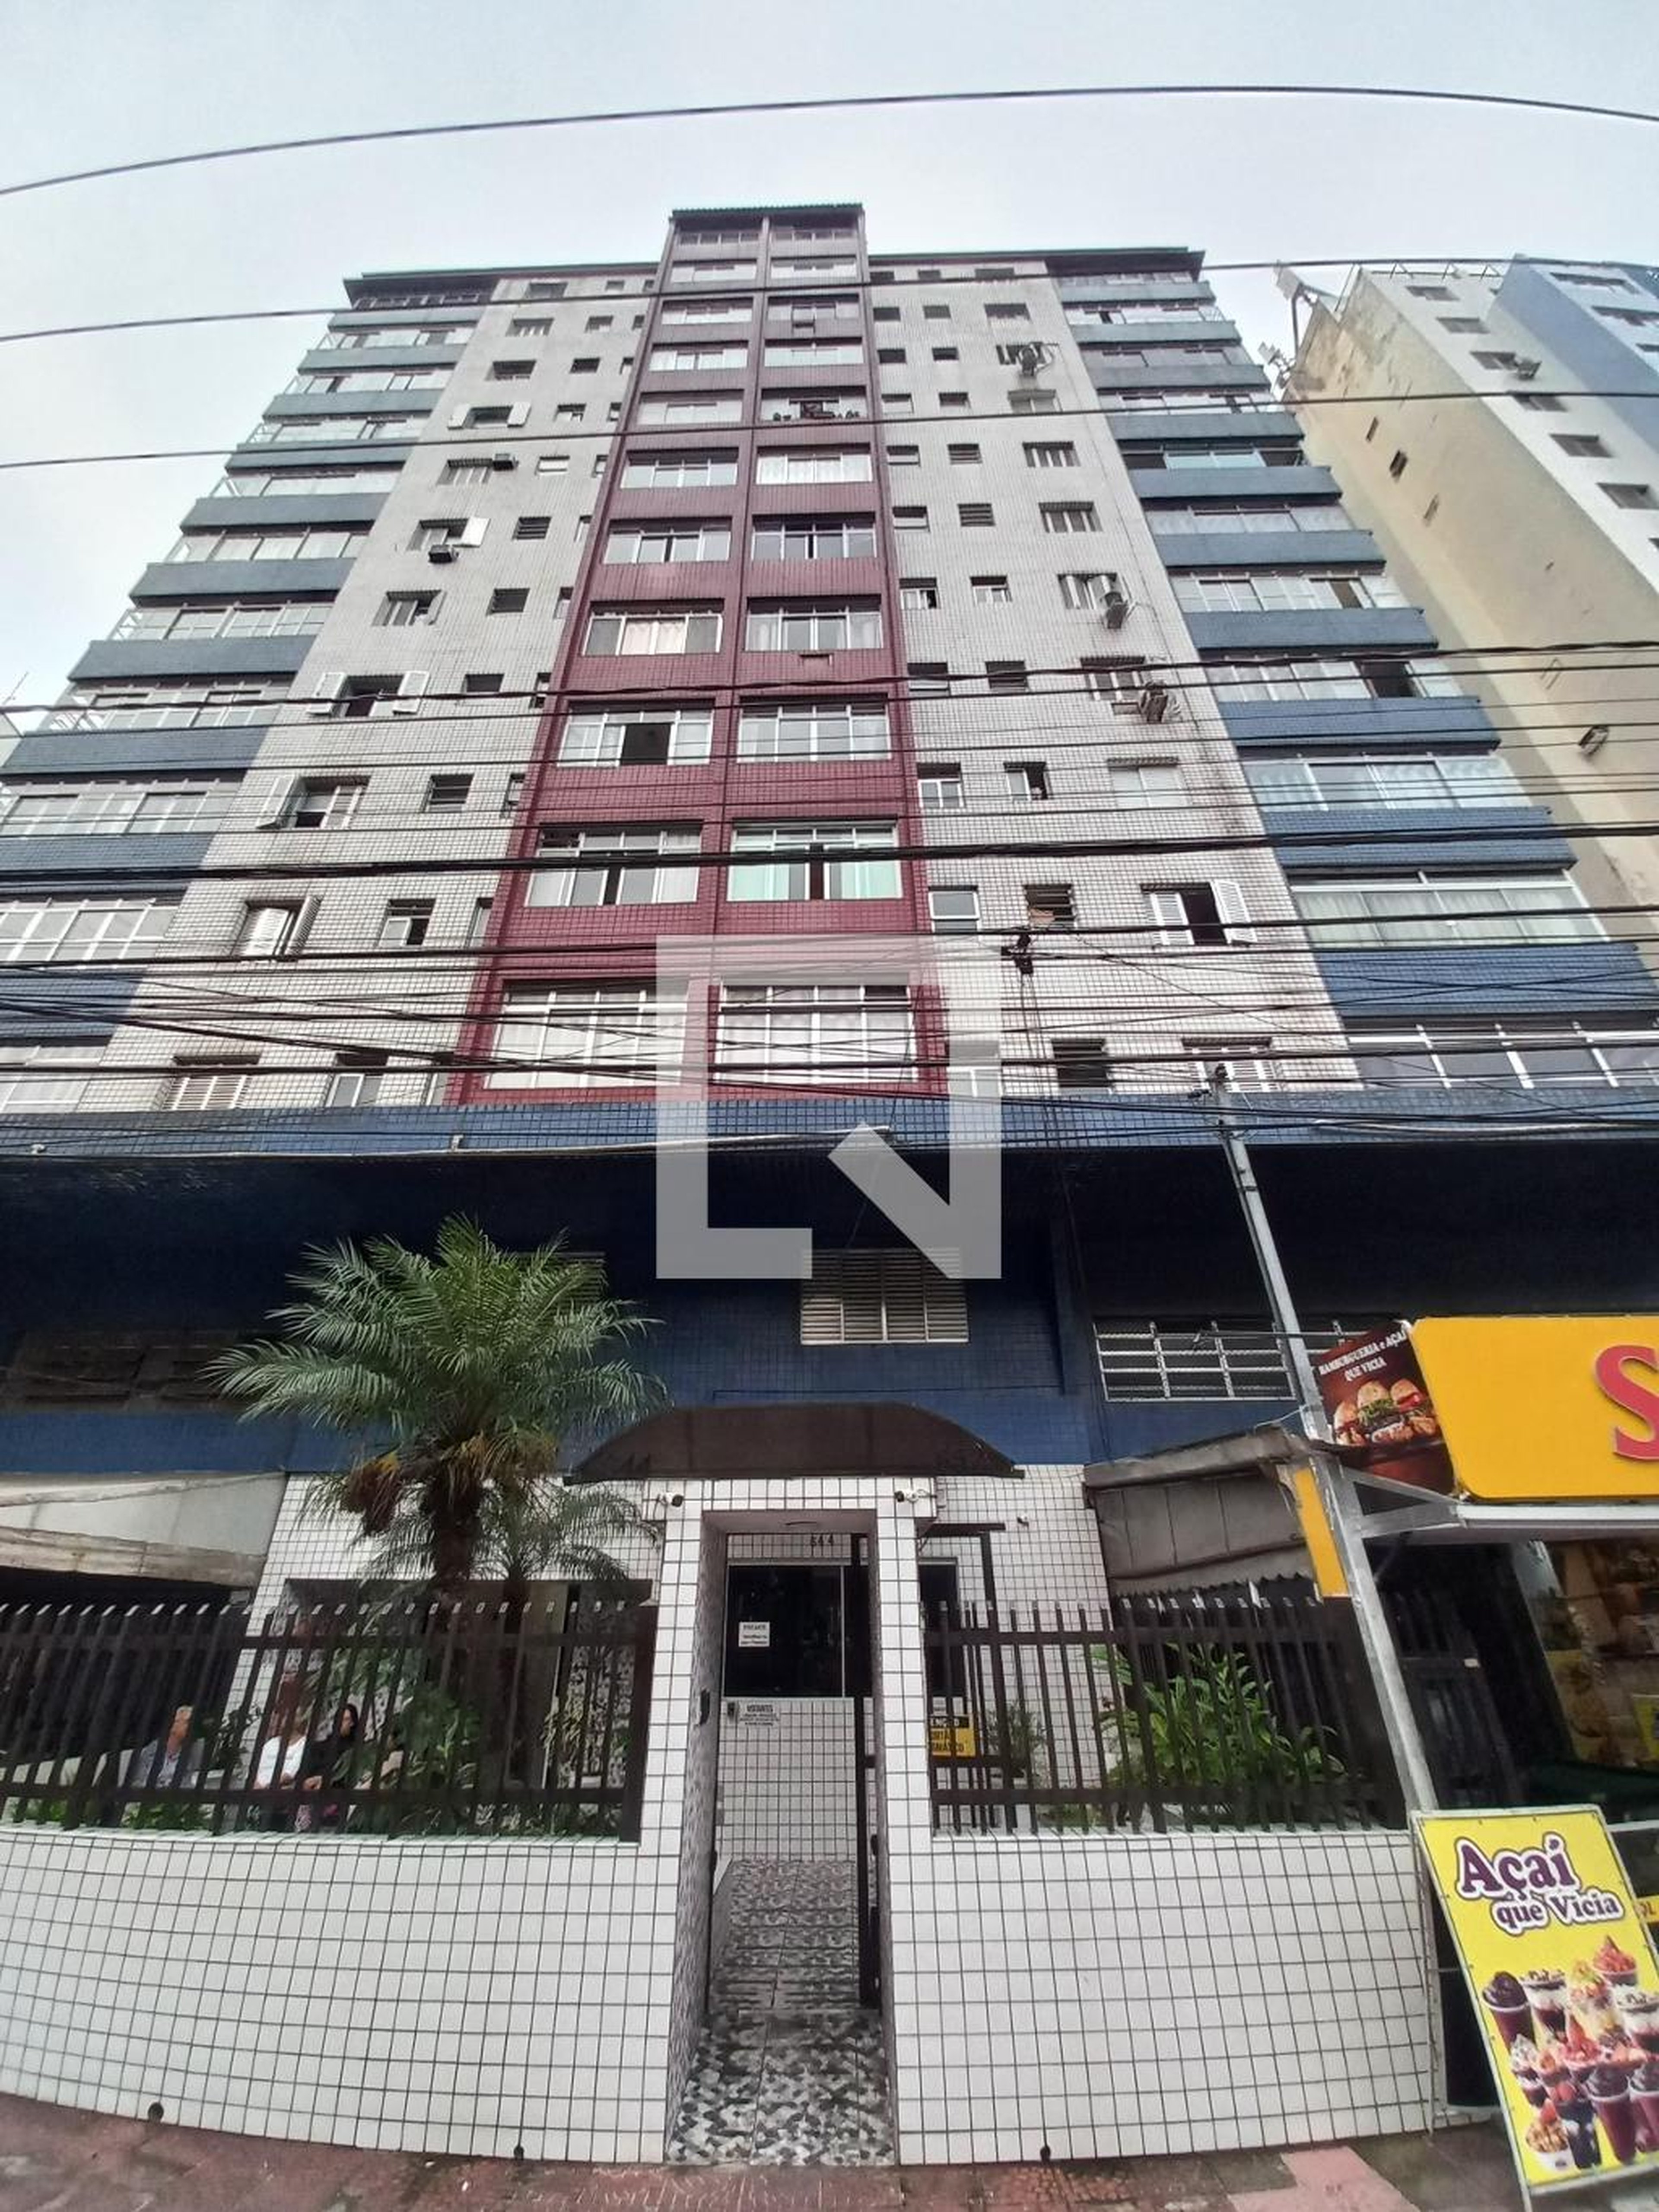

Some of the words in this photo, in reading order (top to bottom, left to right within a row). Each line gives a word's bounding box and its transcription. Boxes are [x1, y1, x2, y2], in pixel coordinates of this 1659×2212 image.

[1344, 1365, 1363, 1381] QUE
[1361, 1356, 1387, 1372] VICIA
[1496, 1902, 1544, 1929] que
[1549, 1893, 1619, 1920] Vicia
